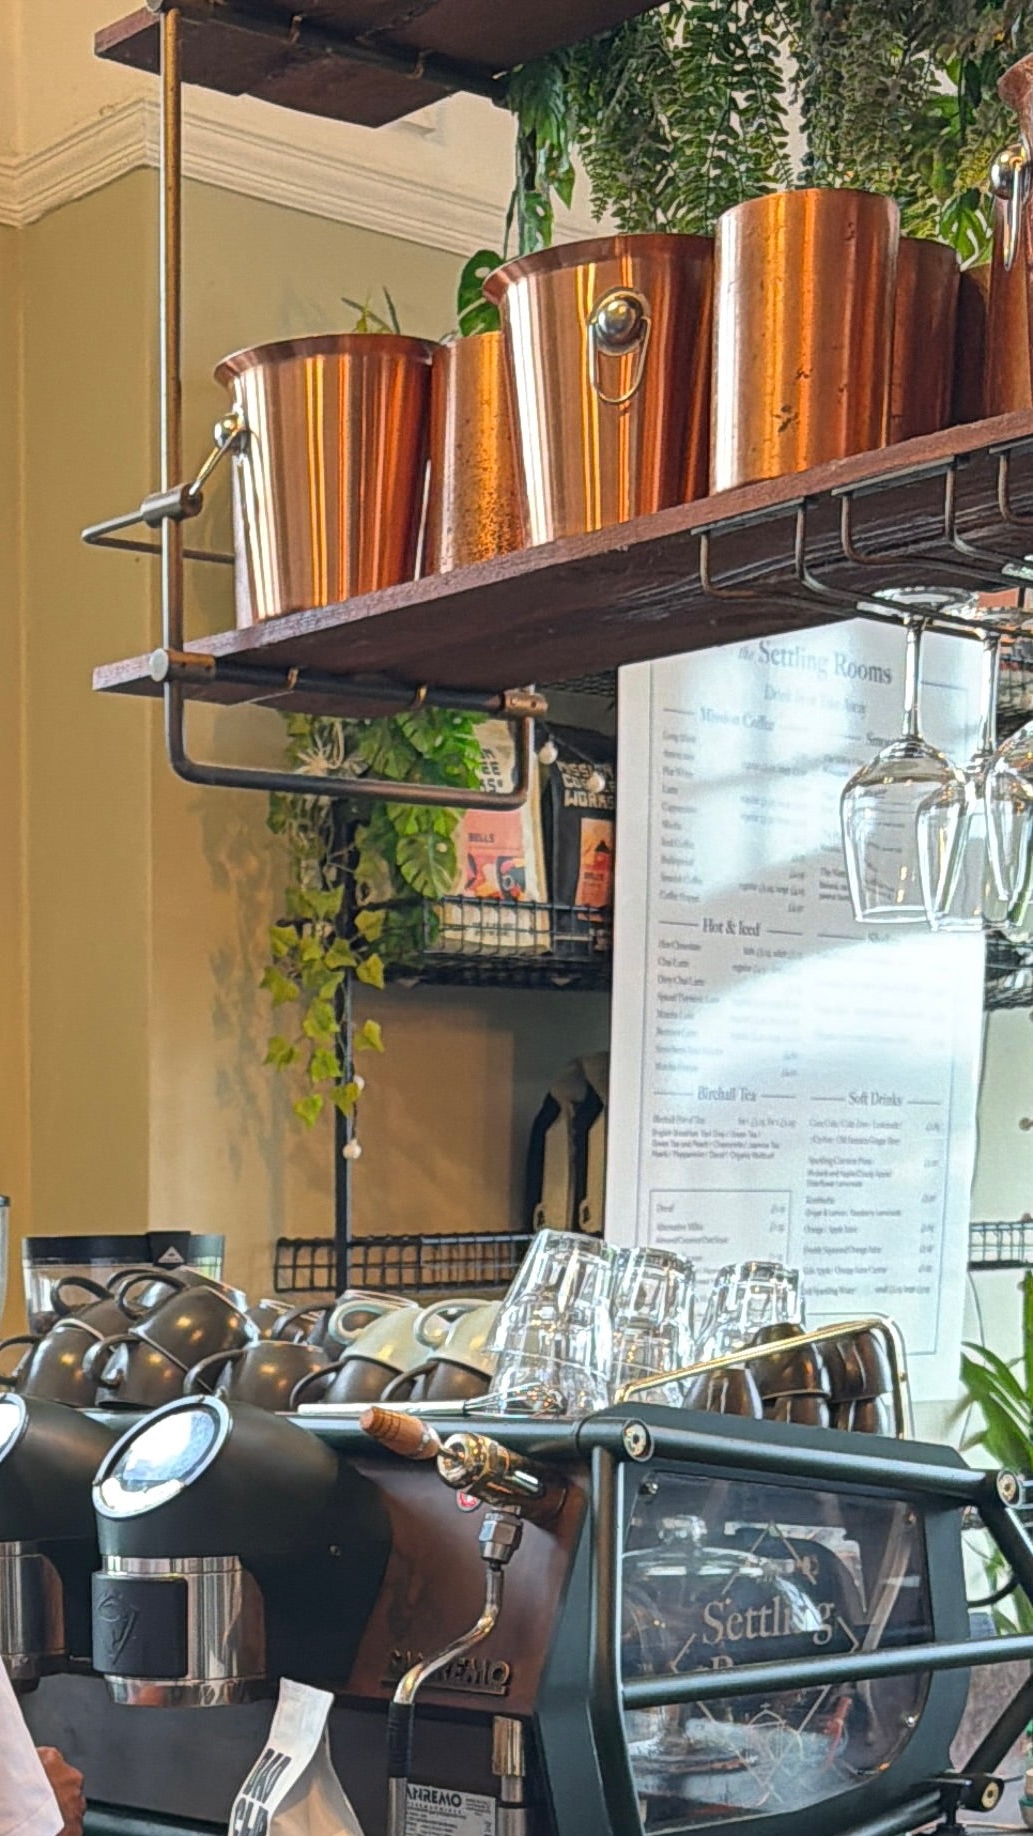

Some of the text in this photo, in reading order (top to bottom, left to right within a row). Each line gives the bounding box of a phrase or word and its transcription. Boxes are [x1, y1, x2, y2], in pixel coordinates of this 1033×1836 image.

[759, 639, 830, 679] Settling
[835, 651, 892, 685] Rooms
[703, 918, 723, 933] Hot
[725, 920, 737, 935] &
[740, 1087, 757, 1102] Tea
[848, 1091, 902, 1107] Soft Drinks
[702, 1596, 835, 1646] Settlig
